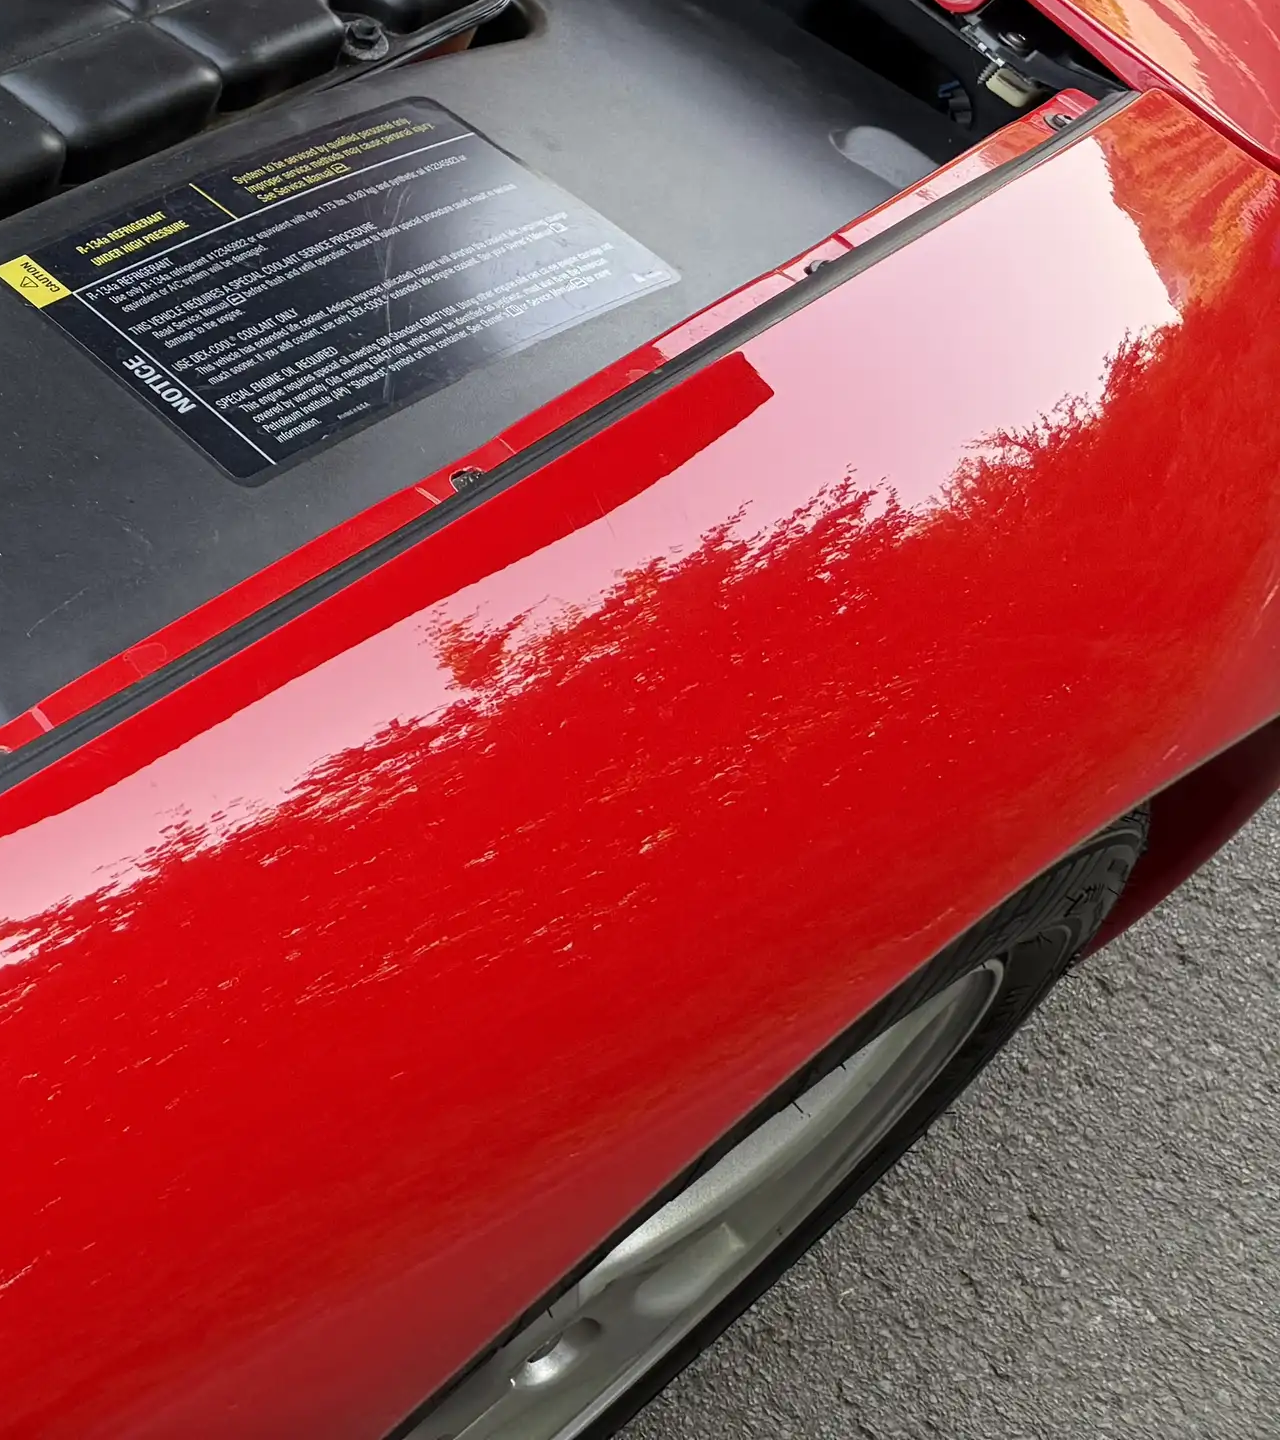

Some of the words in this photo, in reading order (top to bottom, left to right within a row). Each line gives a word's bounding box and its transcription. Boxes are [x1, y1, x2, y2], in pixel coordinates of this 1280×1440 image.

[256, 190, 278, 202] See
[272, 179, 307, 196] Service
[302, 168, 335, 184] Manual
[74, 234, 111, 254] R-134a
[105, 210, 167, 241] REFRIGERANT
[89, 247, 125, 266] UNDER
[119, 238, 146, 253] HIGH
[141, 219, 190, 244] PRESSURE
[107, 292, 127, 304] Use
[123, 284, 146, 298] only
[139, 272, 172, 290] R-134a
[167, 255, 211, 279] refrigerant
[253, 220, 295, 241] equivalent
[20, 260, 61, 293] CAUTION
[84, 281, 121, 300] R-134a
[115, 257, 174, 286] REFRIGERANT
[127, 320, 152, 335] THIS
[147, 305, 185, 326] VEHICLE
[181, 287, 226, 311] REQUIRES
[220, 284, 234, 293] A
[228, 269, 266, 290] SPECIAL
[260, 253, 302, 275] COOLANT
[296, 239, 333, 259] SERVICE
[328, 221, 377, 245] PROCEDURE
[151, 324, 175, 339] Read
[171, 312, 204, 330] Service
[198, 299, 230, 317] Manual
[241, 282, 269, 298] before
[263, 274, 287, 288] flush
[282, 268, 301, 279] and
[296, 260, 317, 273] refill
[171, 358, 193, 371] USE
[235, 318, 278, 341] COOLANT
[274, 308, 300, 323] ONLY
[120, 353, 200, 418] NOTICE
[214, 386, 254, 409] SPECIAL
[249, 372, 285, 392] ENGINE
[280, 365, 299, 377] OIL
[294, 345, 339, 370] REQUIRED
